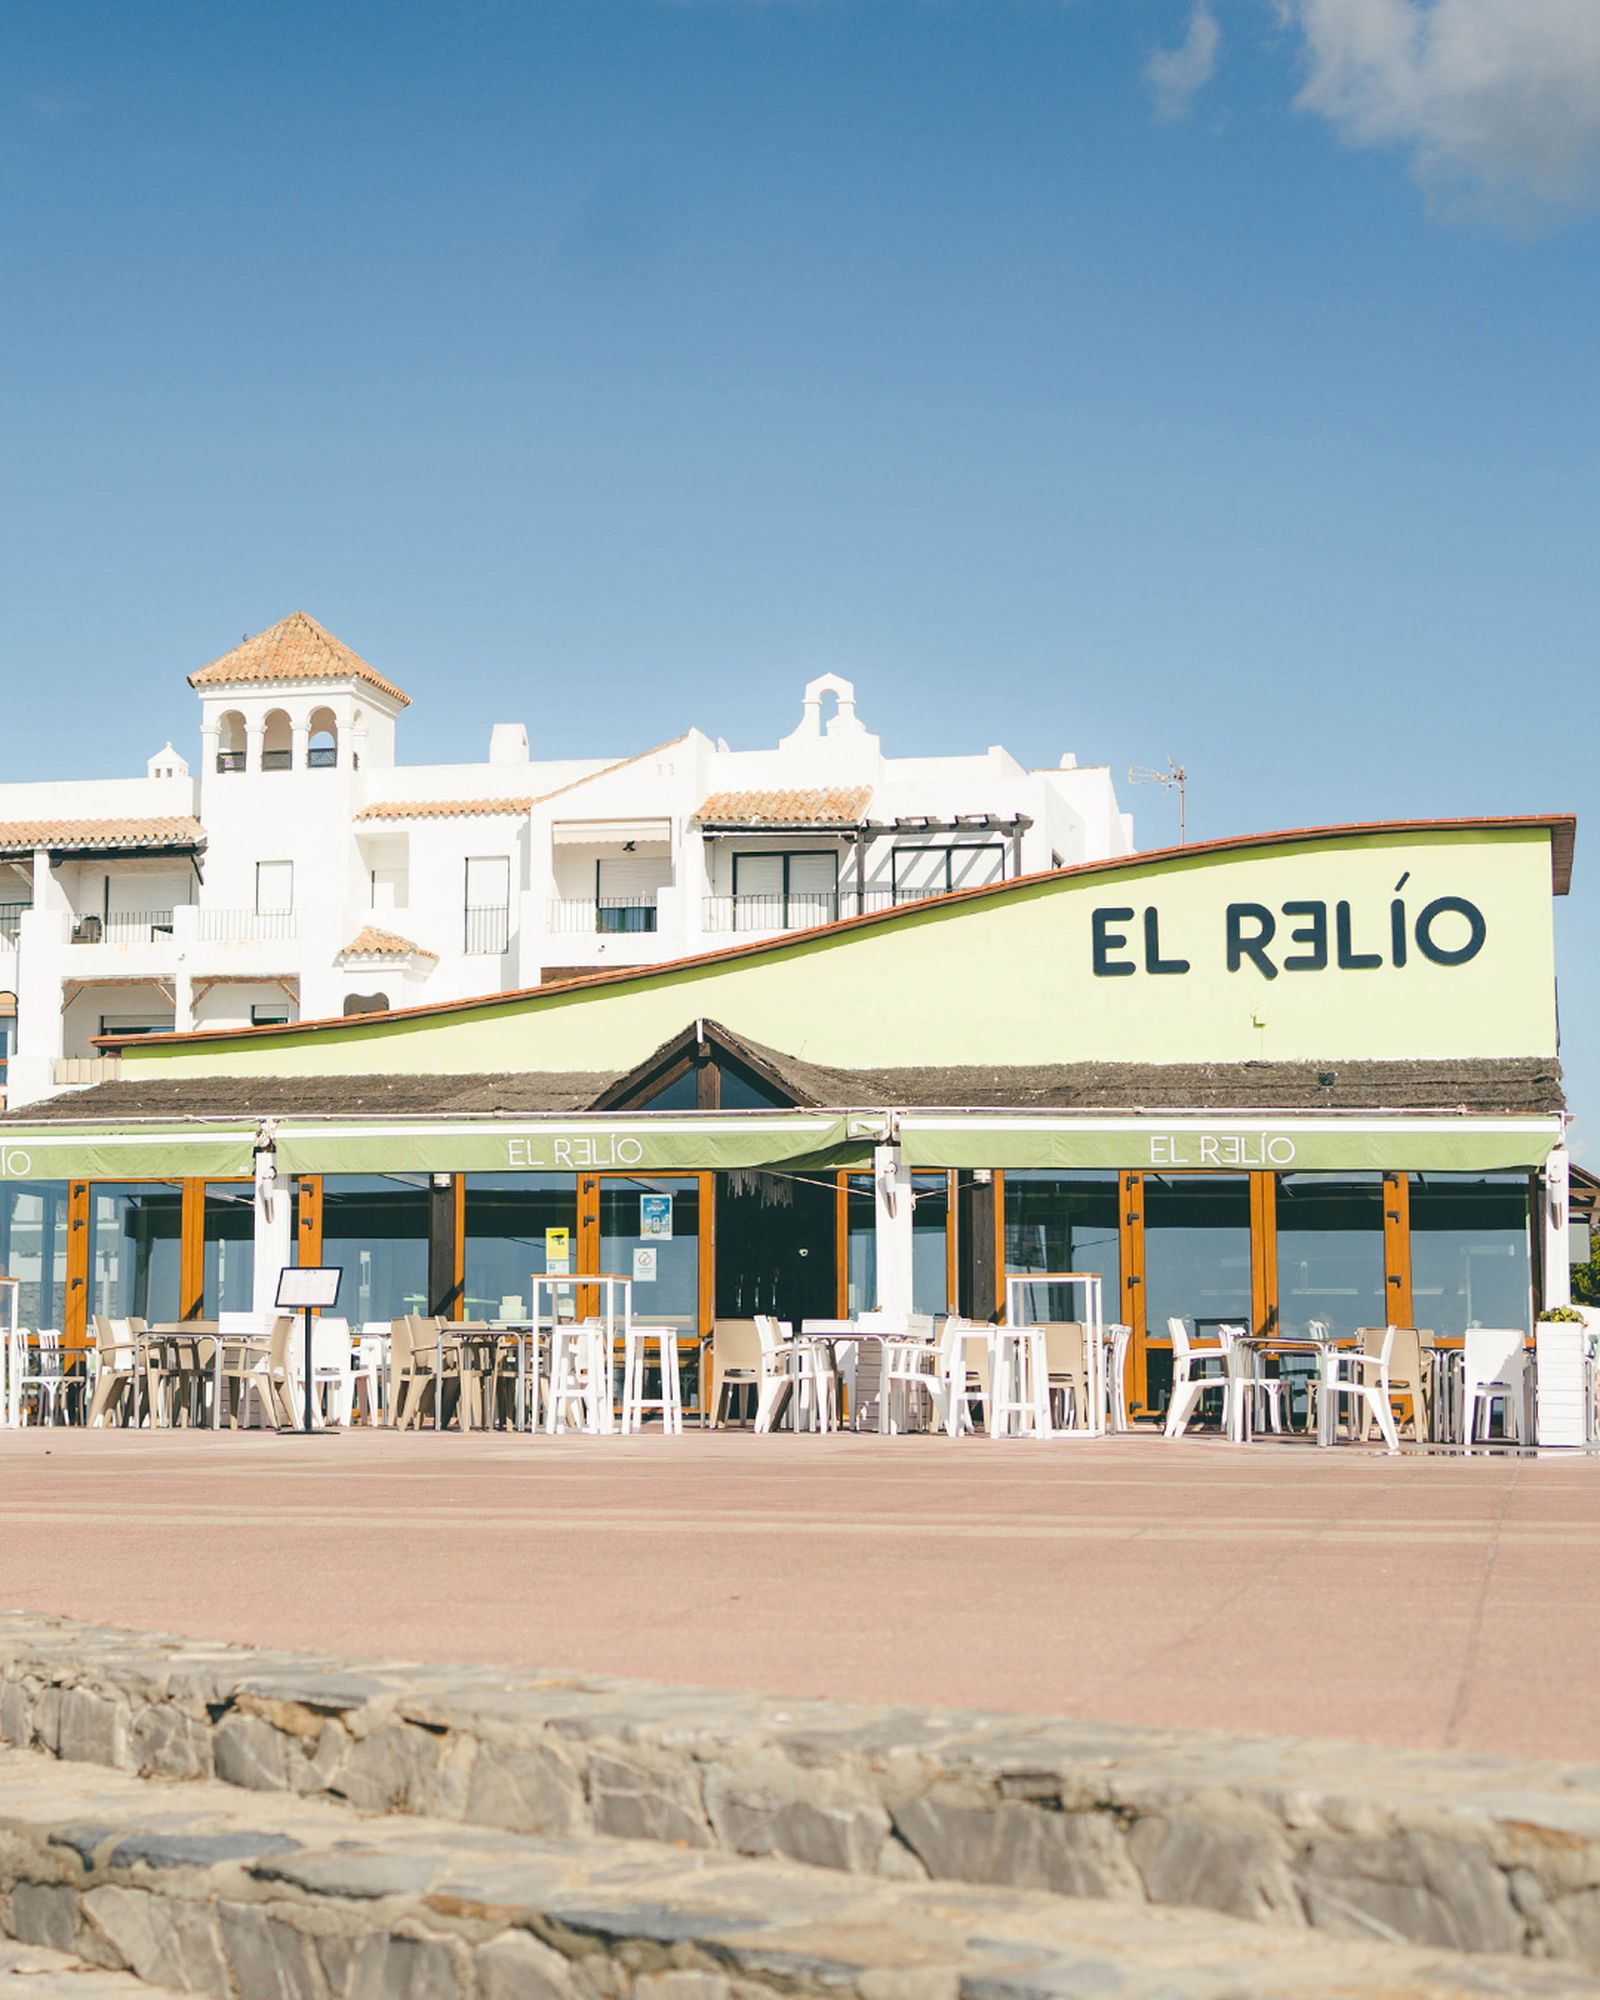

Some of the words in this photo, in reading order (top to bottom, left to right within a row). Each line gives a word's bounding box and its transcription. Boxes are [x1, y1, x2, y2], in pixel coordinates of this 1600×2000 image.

[1092, 906, 1190, 977] EL
[508, 1139, 544, 1166] EL
[1150, 1136, 1189, 1164] EL
